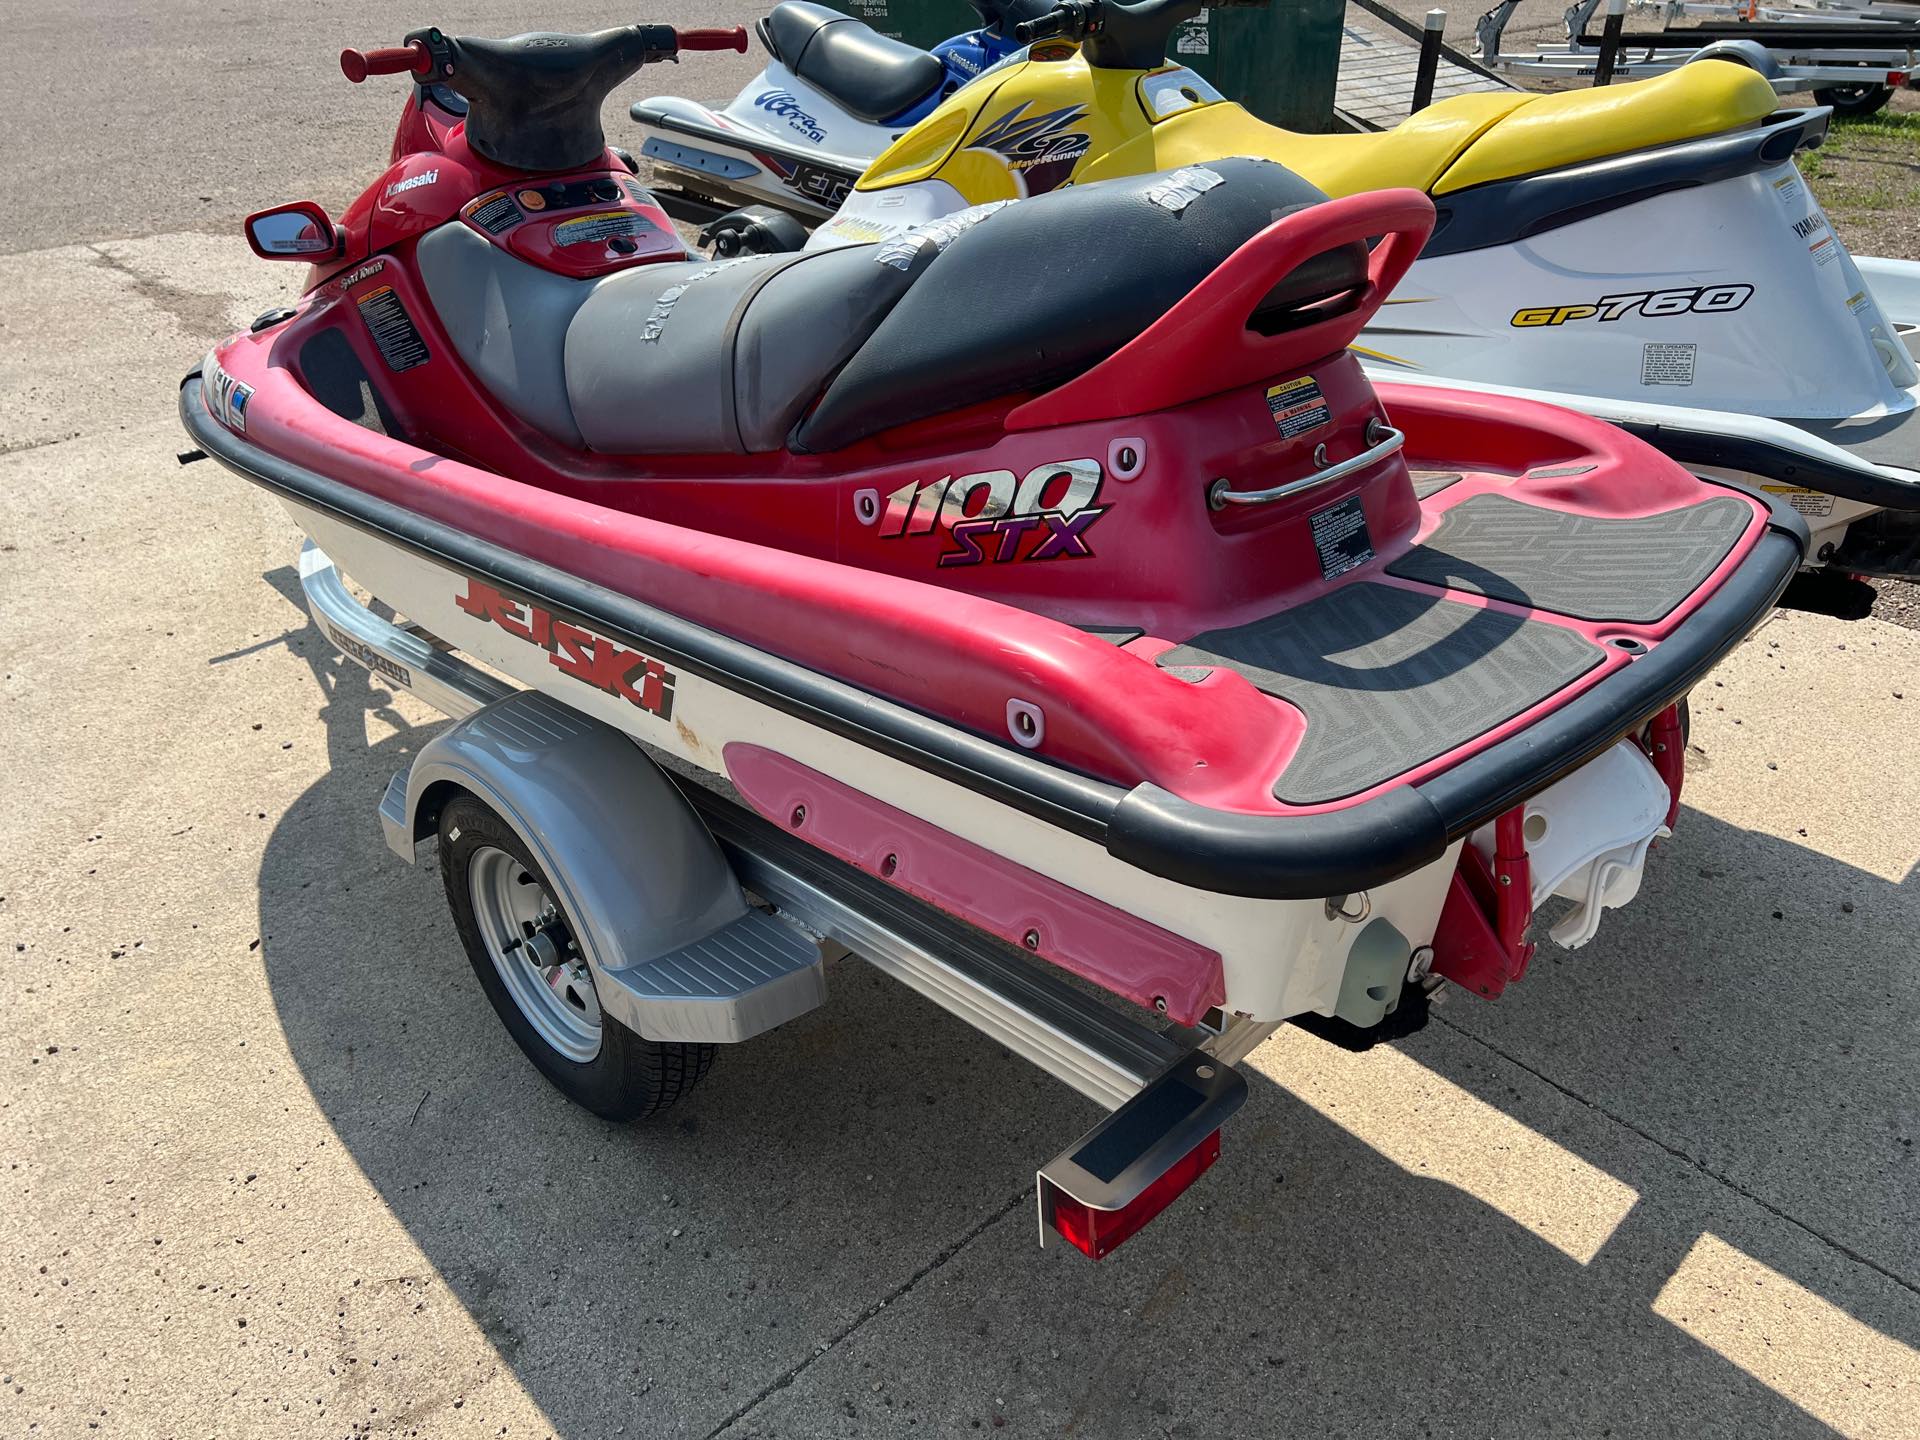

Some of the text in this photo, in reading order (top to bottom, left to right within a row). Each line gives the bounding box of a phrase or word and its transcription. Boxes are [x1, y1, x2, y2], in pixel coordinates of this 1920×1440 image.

[948, 49, 981, 74] Kawasaki
[755, 90, 828, 134] Ultra
[1007, 148, 1088, 171] WaveRunner
[385, 169, 439, 199] Kawasaki
[1279, 380, 1303, 392] CAUTION
[877, 458, 1102, 539] 1100
[937, 504, 1115, 567] STX
